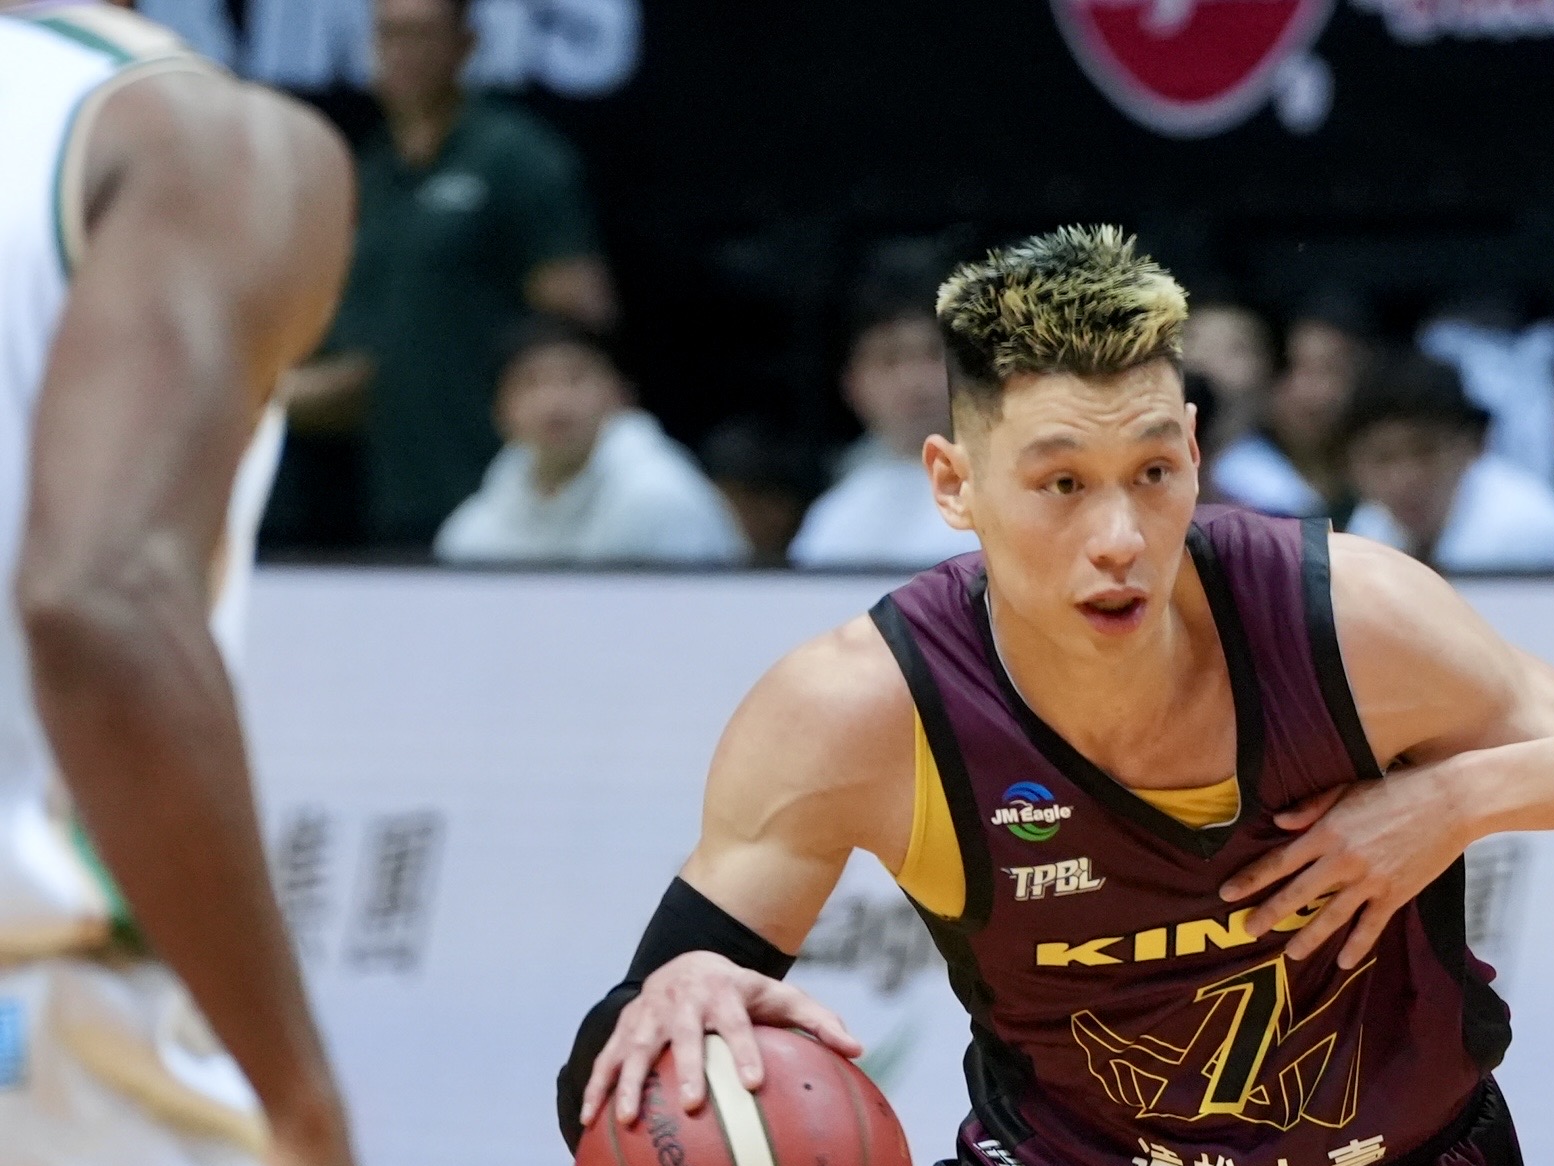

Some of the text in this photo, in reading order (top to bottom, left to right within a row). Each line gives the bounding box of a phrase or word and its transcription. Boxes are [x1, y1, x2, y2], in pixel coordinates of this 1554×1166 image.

[991, 803, 1072, 825] JM Eagle
[1001, 857, 1107, 901] TPBL
